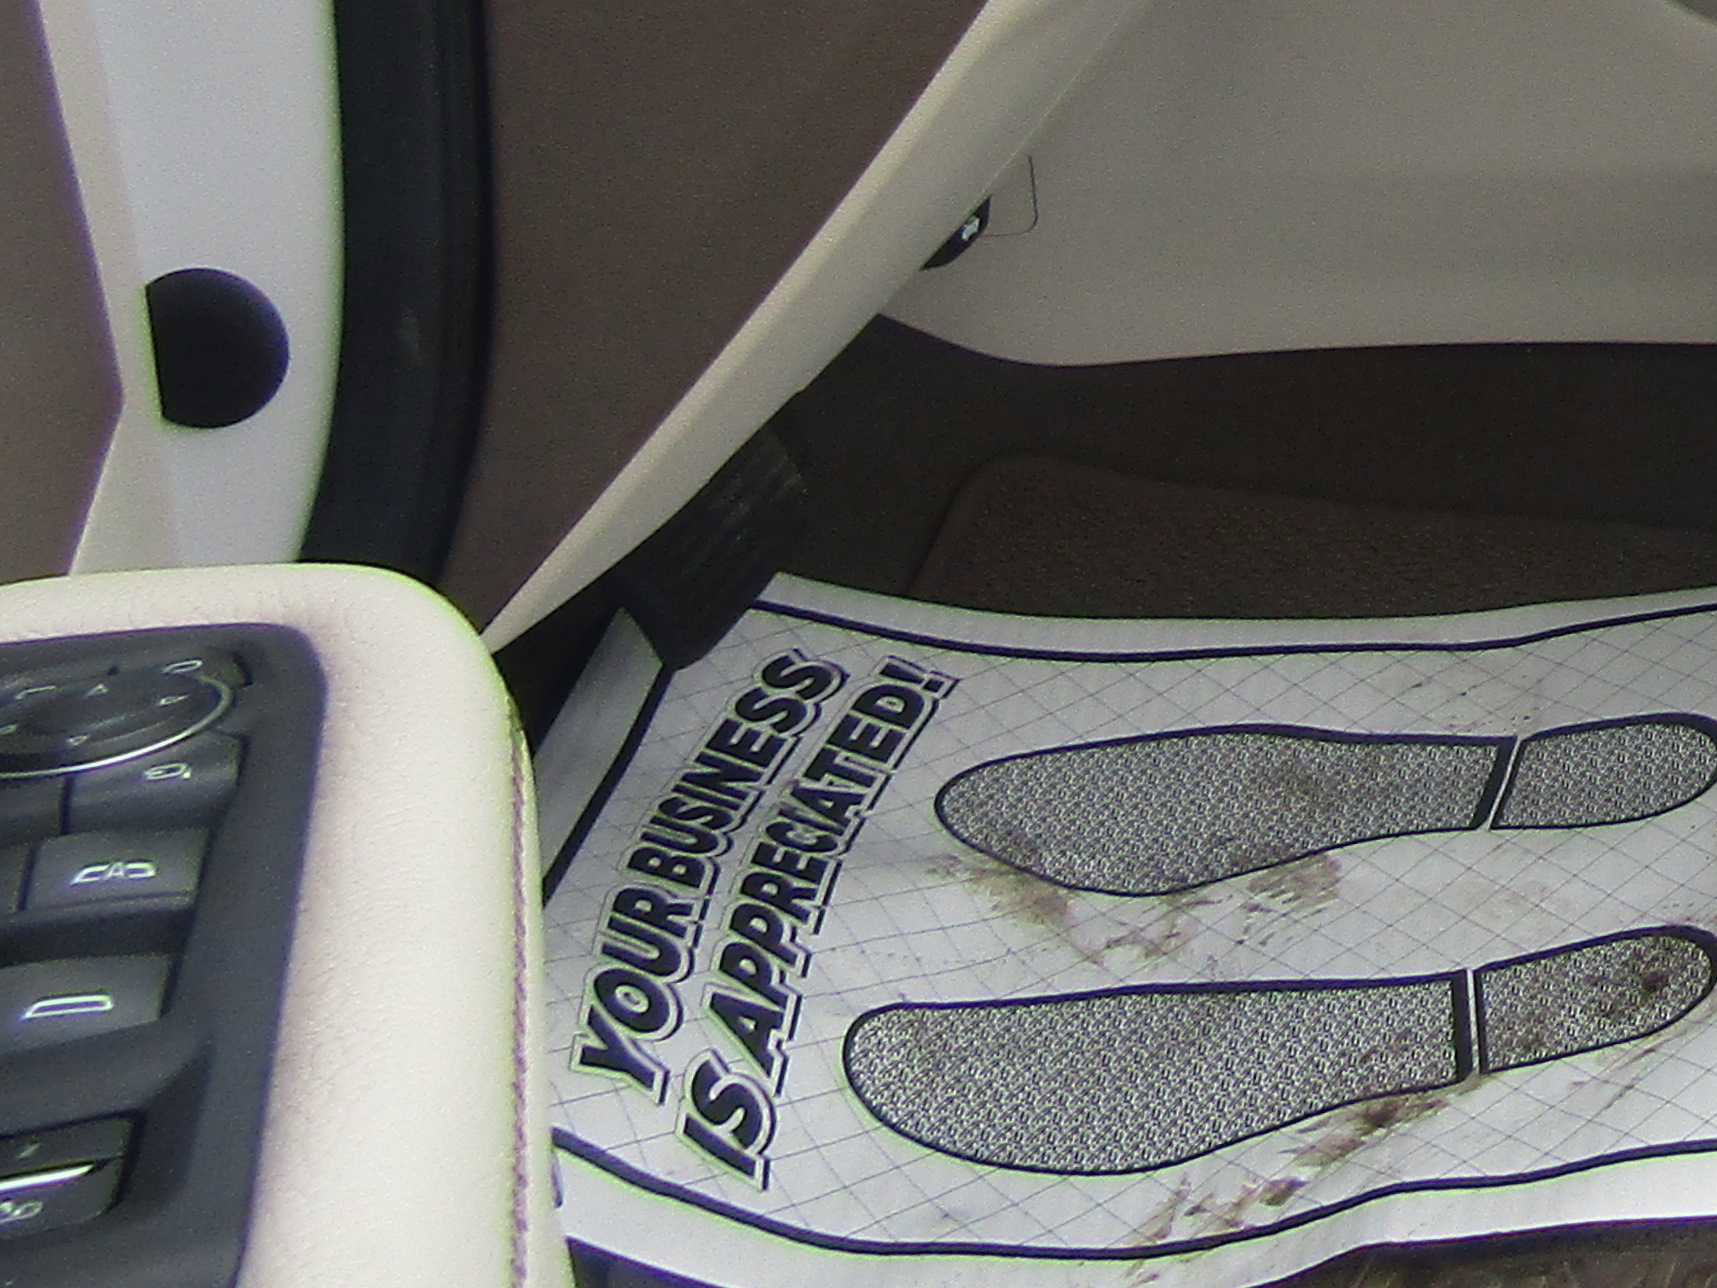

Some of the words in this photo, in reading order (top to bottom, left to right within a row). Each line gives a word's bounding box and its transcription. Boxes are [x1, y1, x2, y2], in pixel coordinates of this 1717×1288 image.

[622, 649, 850, 894] BUSINESS
[703, 656, 960, 1098] APPRECIATED!
[572, 883, 709, 1105] YOUR
[676, 1049, 777, 1191] IS
